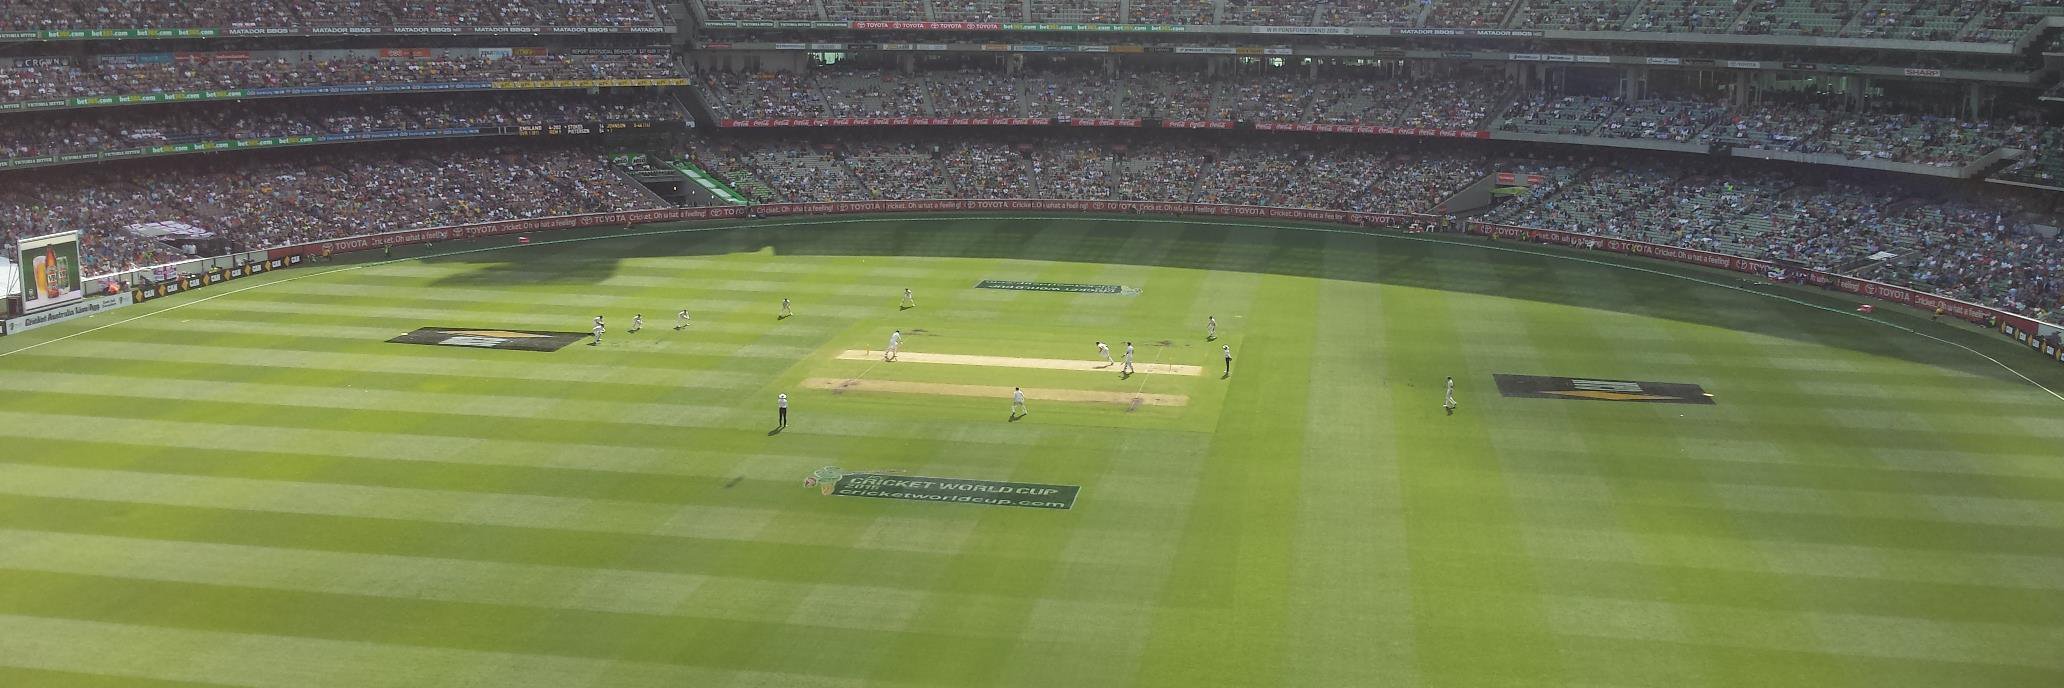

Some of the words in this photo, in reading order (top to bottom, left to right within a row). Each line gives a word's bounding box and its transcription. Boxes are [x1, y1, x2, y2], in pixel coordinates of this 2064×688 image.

[25, 58, 60, 67] CROWN
[1235, 207, 1265, 215] TOYOTA
[336, 240, 368, 250] TOYOTA
[1880, 287, 1910, 301] TOYOTA
[48, 310, 75, 320] Australia
[850, 476, 938, 490] CRICKET
[940, 481, 1012, 494] WORLD
[1016, 488, 1058, 496] CUP
[840, 489, 1065, 508] cricketworldcup.com
